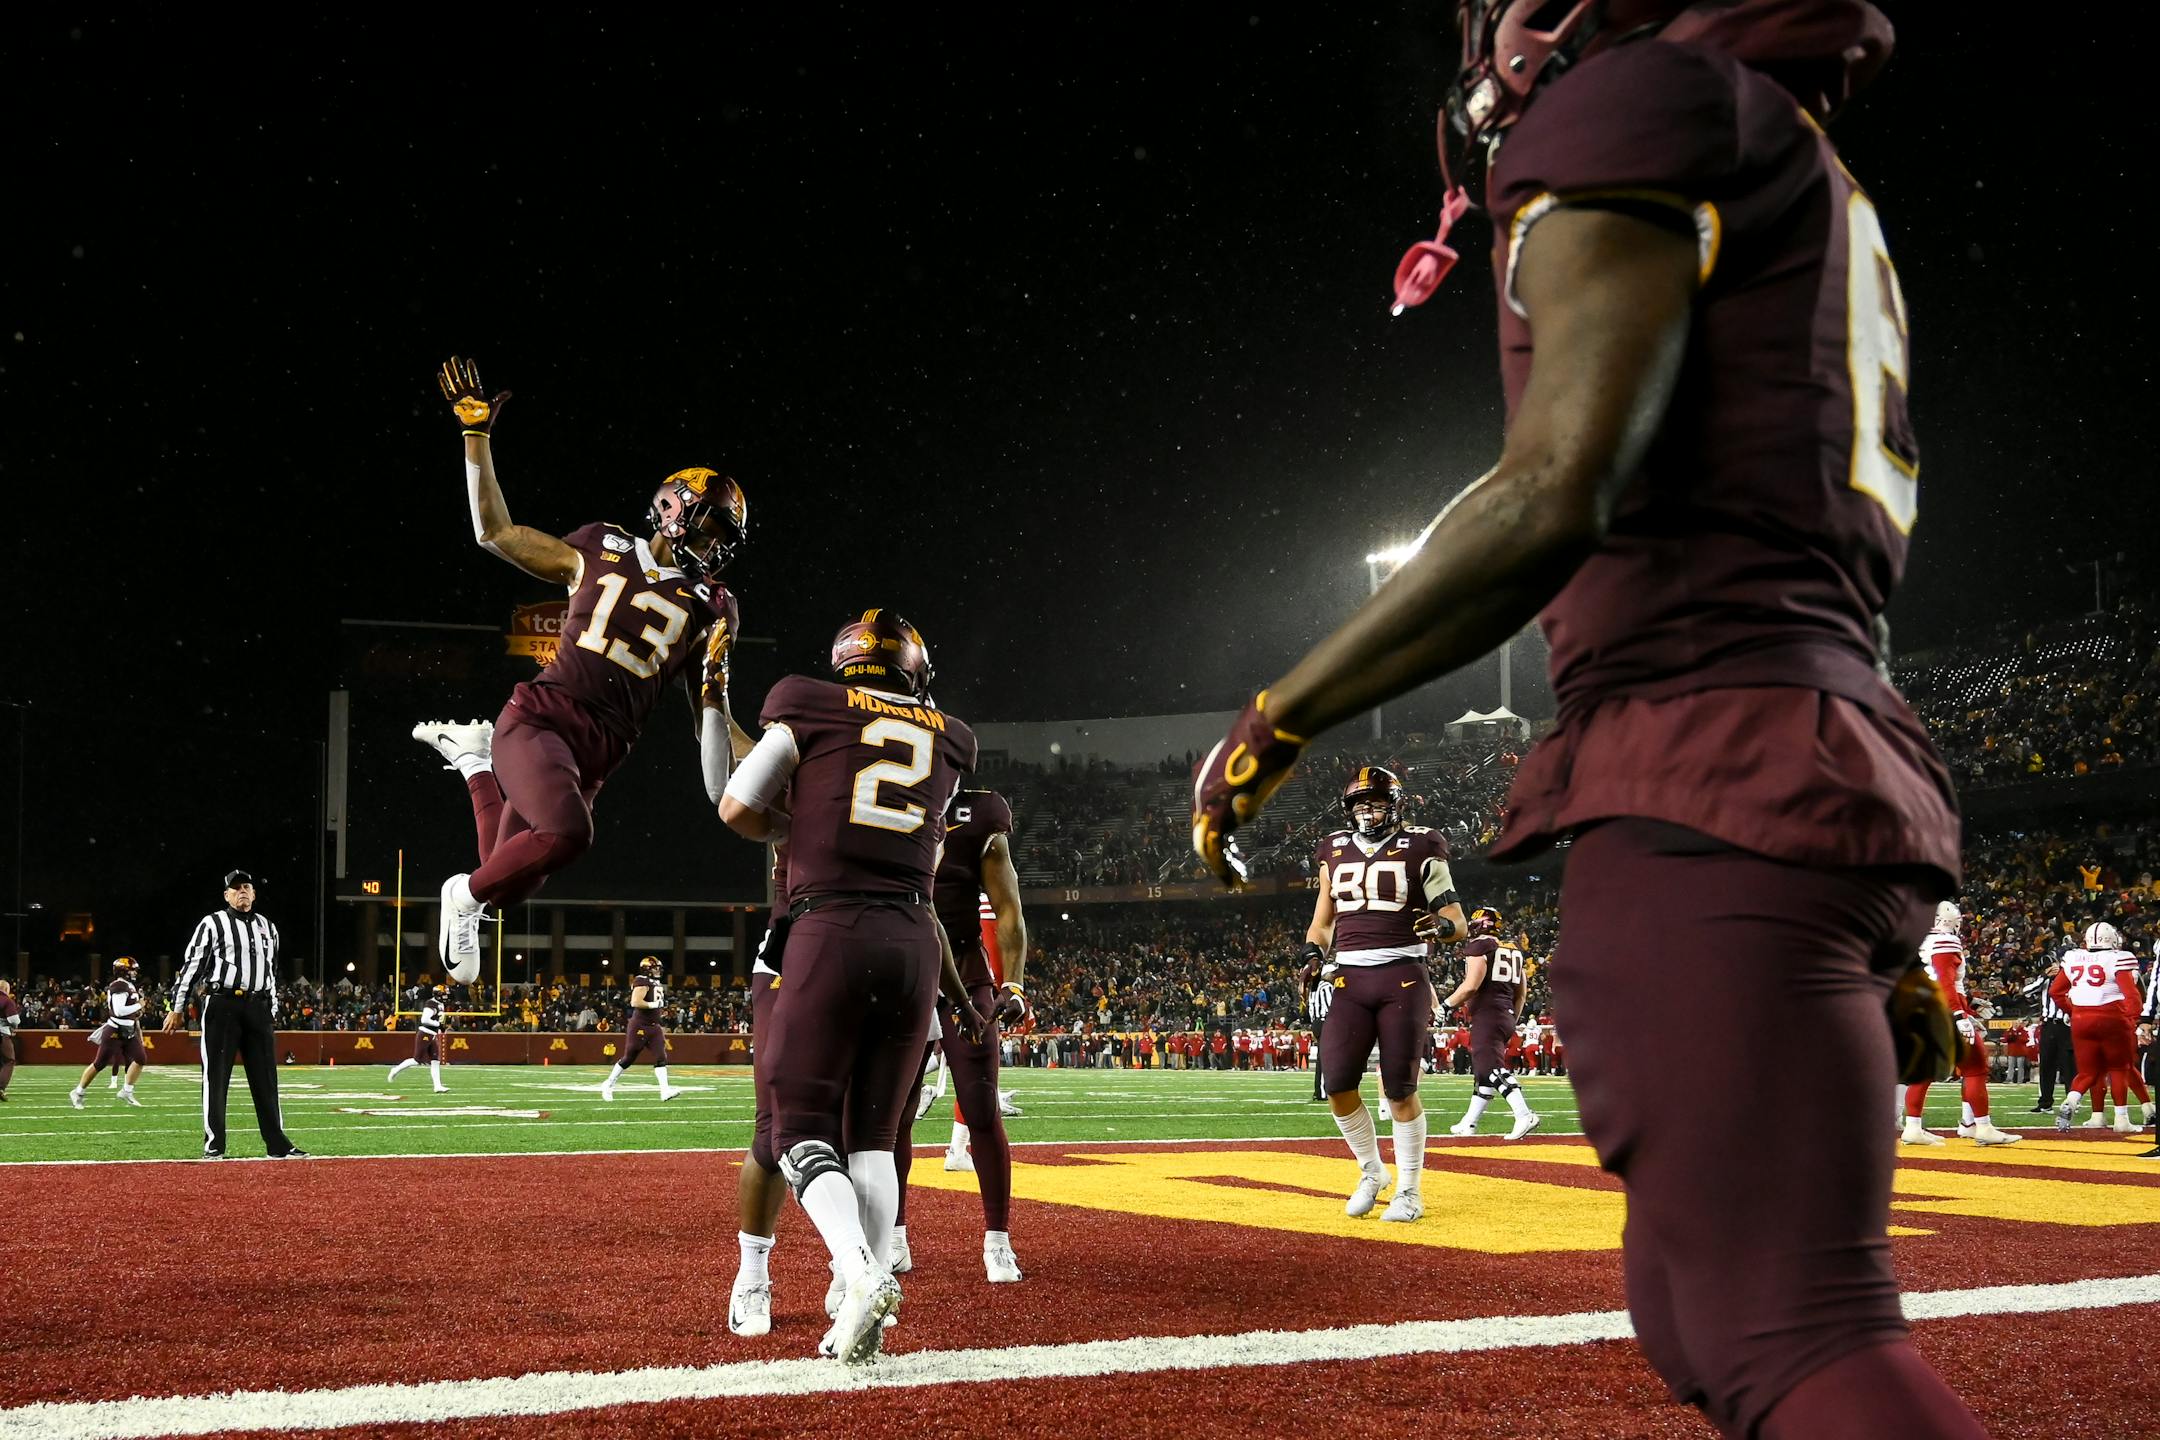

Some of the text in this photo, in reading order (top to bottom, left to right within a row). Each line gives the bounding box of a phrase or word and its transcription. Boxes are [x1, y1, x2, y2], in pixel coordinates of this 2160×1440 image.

[576, 573, 689, 679] 13
[529, 641, 557, 652] STA
[844, 664, 886, 677] SKI-U-MAH
[850, 716, 935, 834] 2
[362, 881, 381, 895] 40
[1305, 877, 1319, 889] 72
[1330, 861, 1409, 913] 80
[1065, 890, 1080, 901] 10
[1148, 887, 1162, 898] 15
[1492, 947, 1523, 984] 60
[2070, 964, 2107, 988] 79
